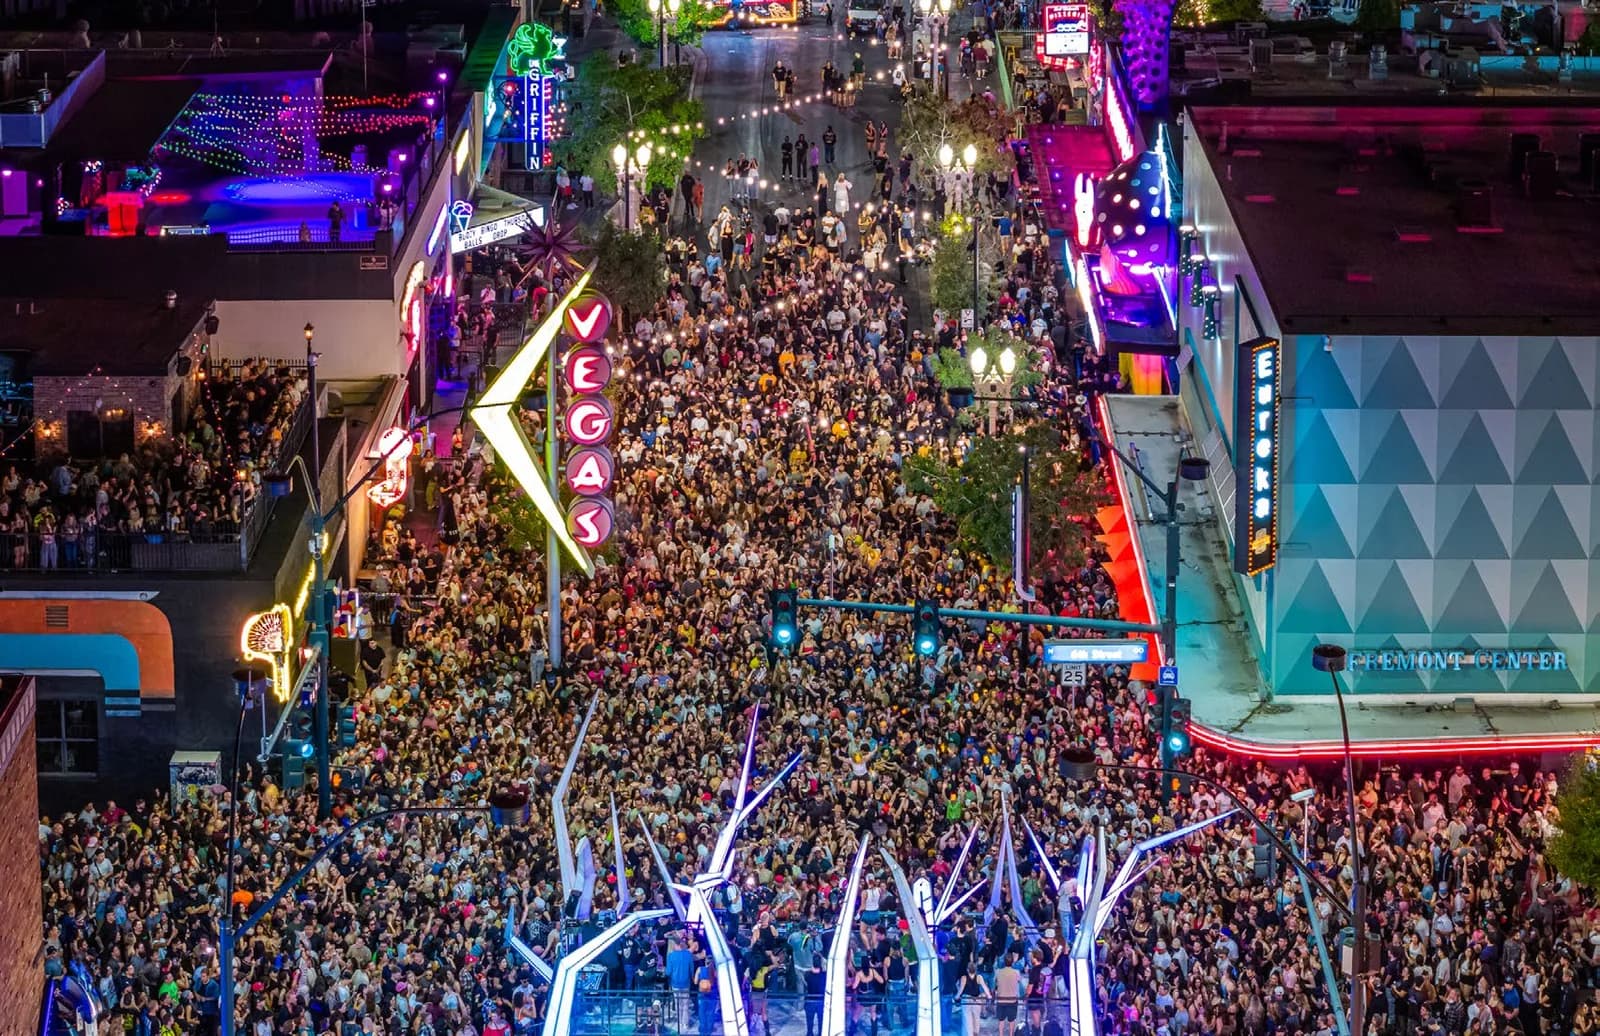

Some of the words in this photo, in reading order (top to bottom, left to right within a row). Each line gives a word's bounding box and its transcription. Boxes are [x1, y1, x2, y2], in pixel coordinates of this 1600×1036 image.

[528, 69, 540, 169] GRIFFIN
[464, 237, 482, 249] BALLS
[493, 229, 508, 240] DROP
[568, 304, 611, 544] VEGAS
[1255, 351, 1272, 518] Eureka
[1091, 649, 1123, 660] Street
[1347, 650, 1464, 672] FREMONT
[1474, 649, 1568, 671] CENTER
[1064, 671, 1084, 682] 25
